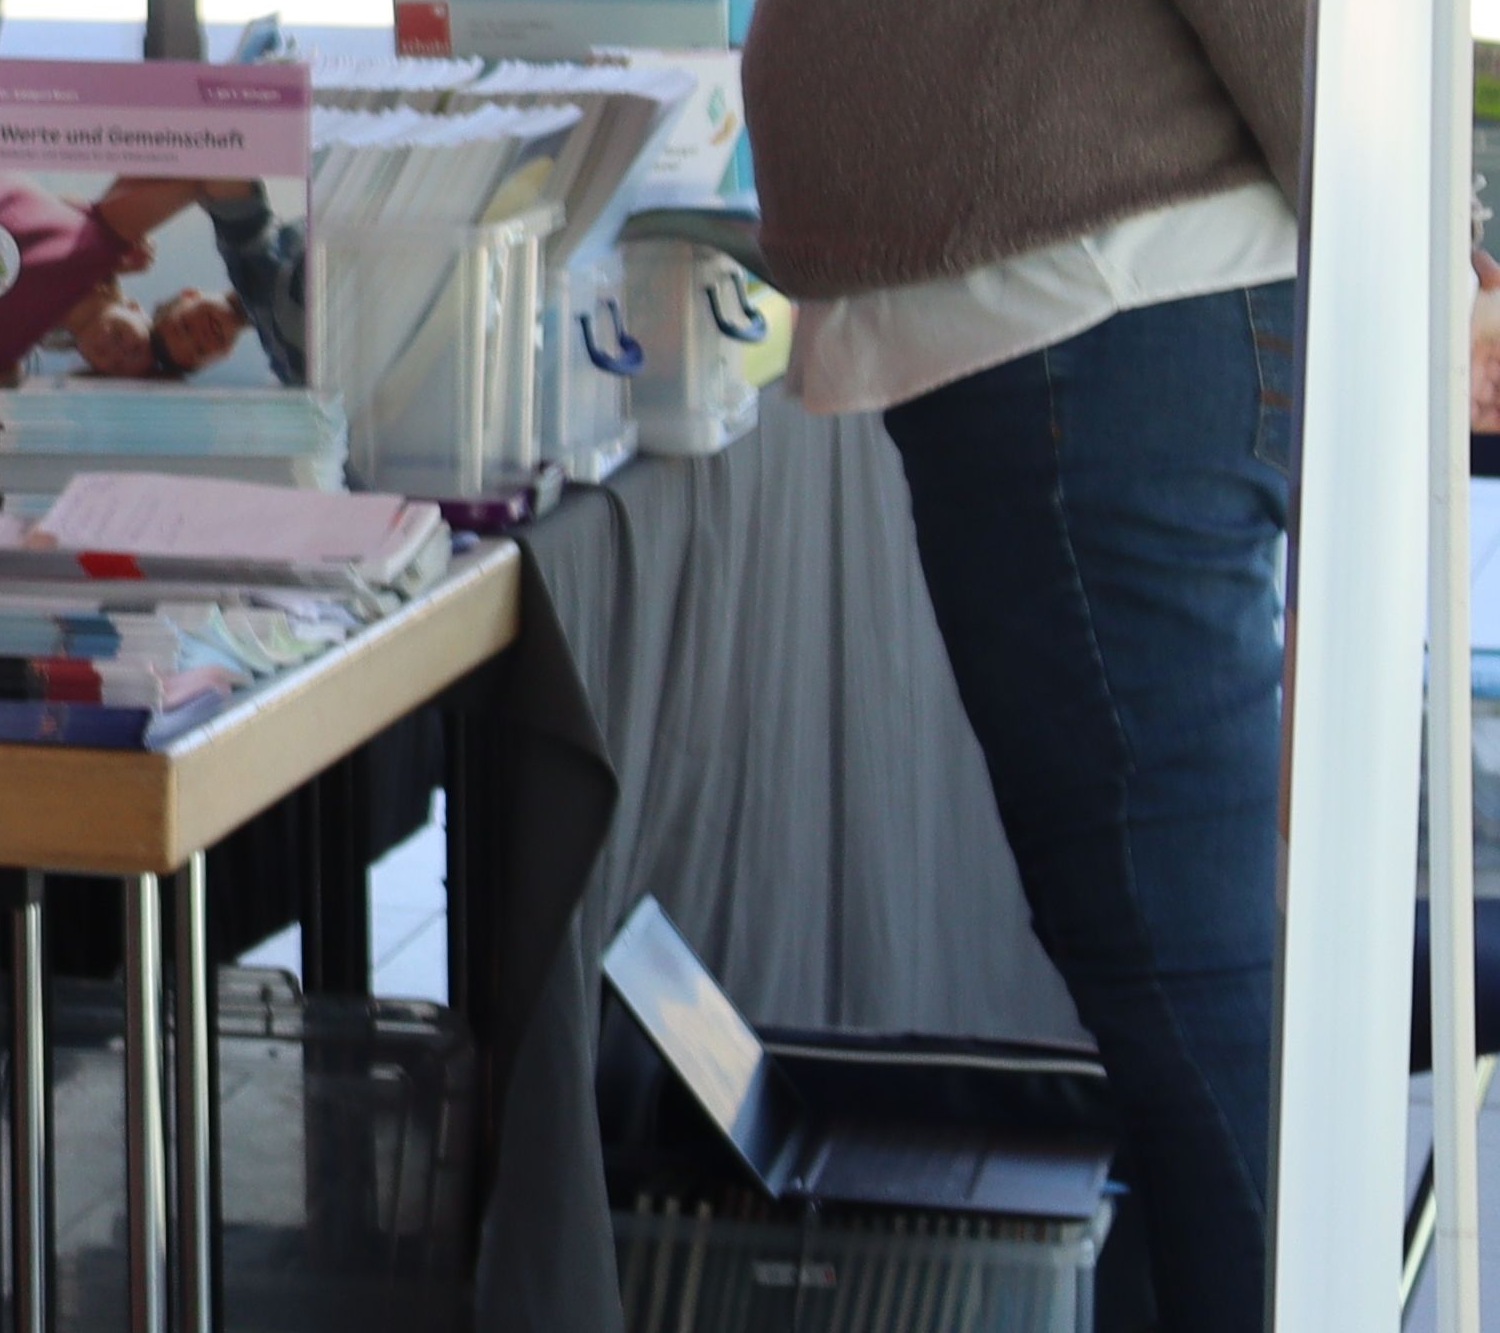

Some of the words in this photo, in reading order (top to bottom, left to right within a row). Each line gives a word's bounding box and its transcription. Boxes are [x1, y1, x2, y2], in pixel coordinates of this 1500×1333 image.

[0, 124, 61, 145] Werte
[66, 123, 103, 145] und
[108, 125, 246, 151] Gemeinschaft
